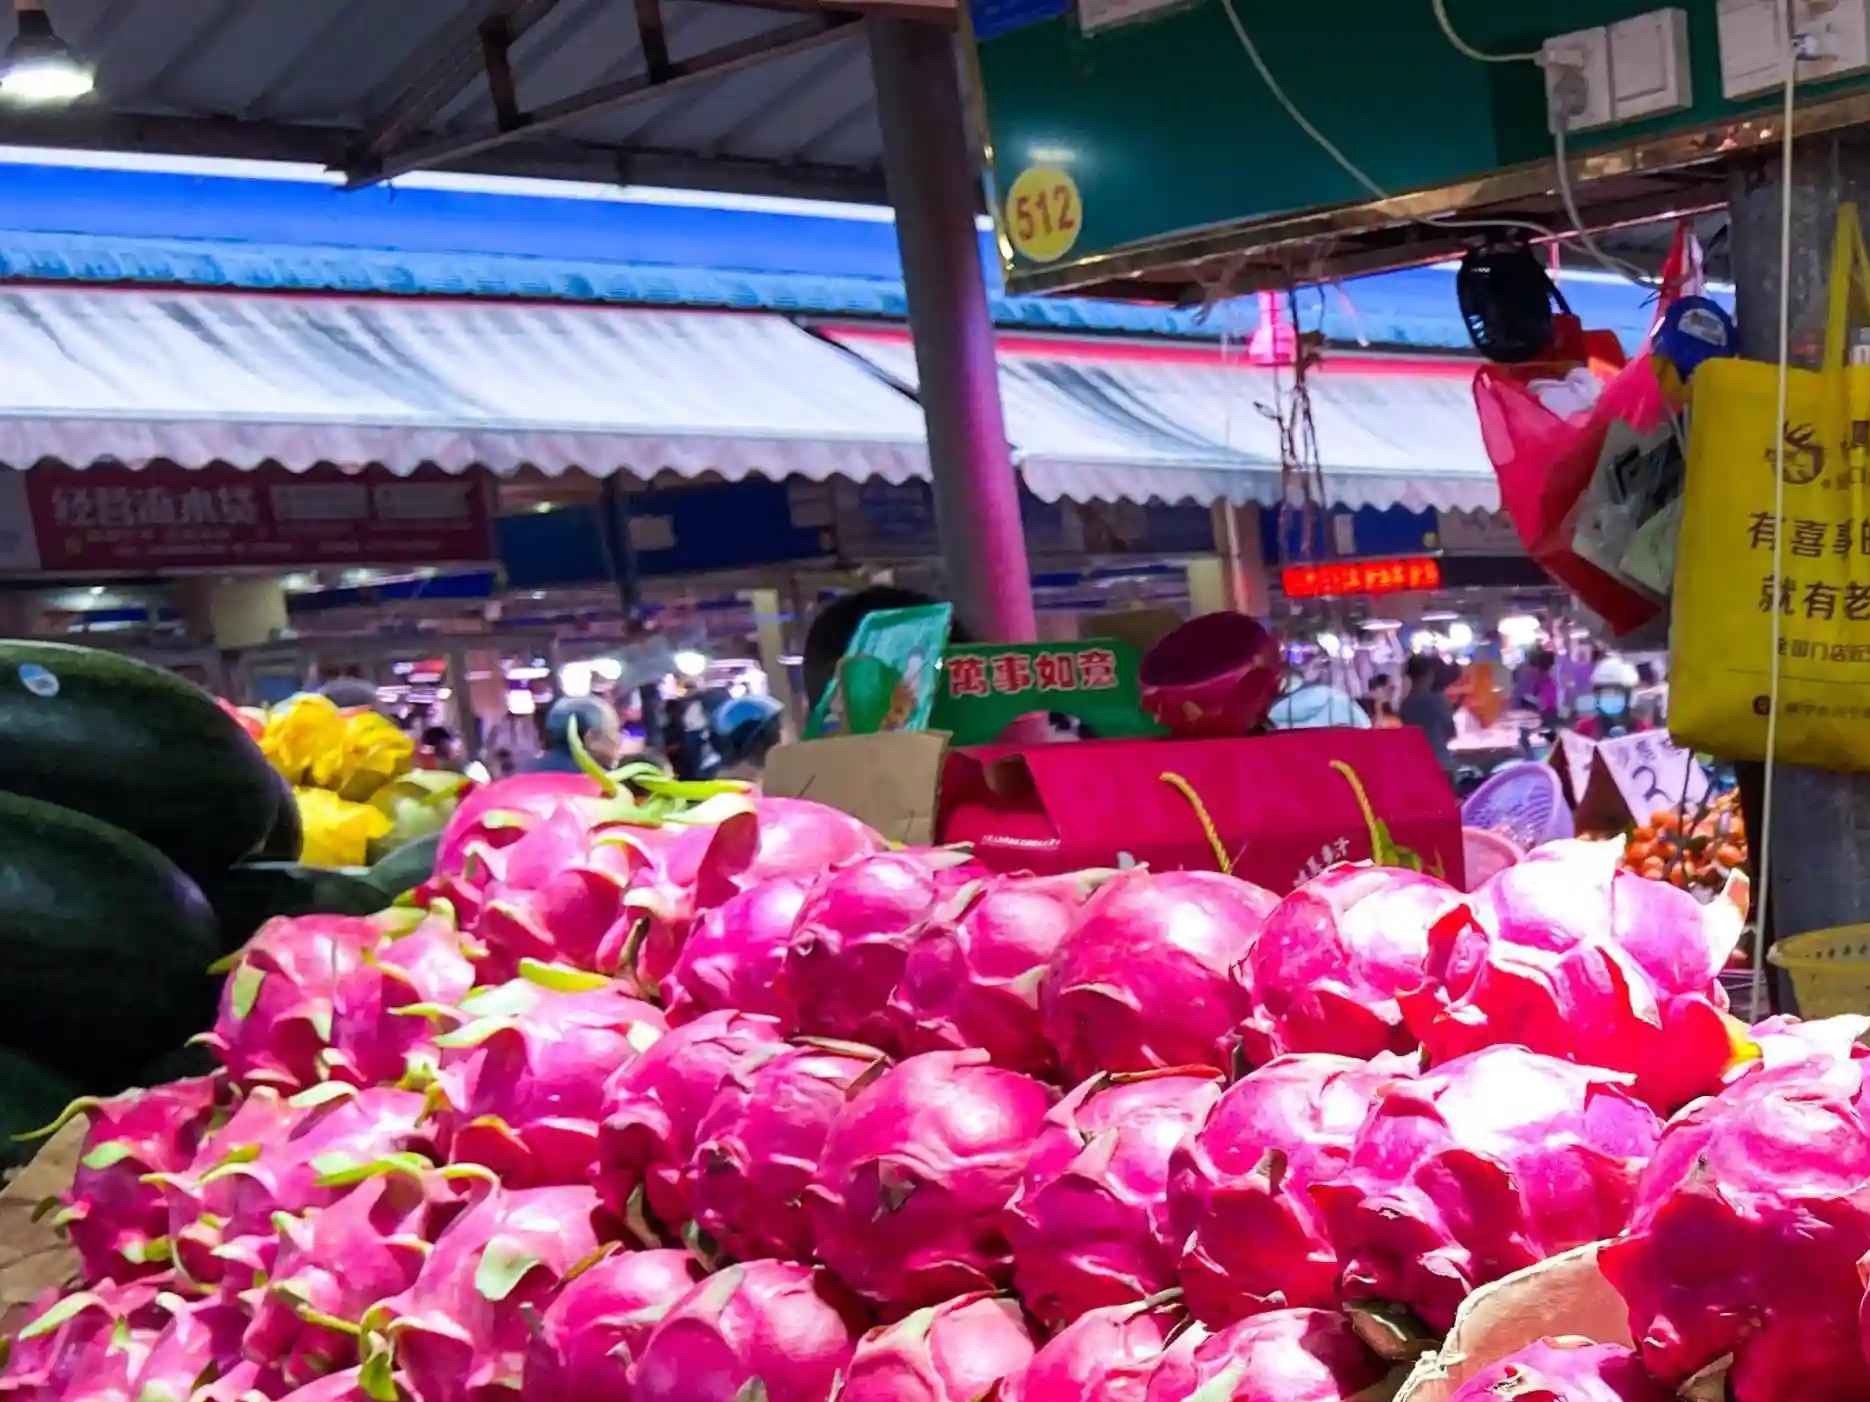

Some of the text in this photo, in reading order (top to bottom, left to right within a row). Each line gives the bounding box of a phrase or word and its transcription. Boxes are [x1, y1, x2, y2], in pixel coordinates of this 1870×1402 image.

[1014, 187, 1076, 244] 512
[948, 649, 1117, 698] 萬事如意
